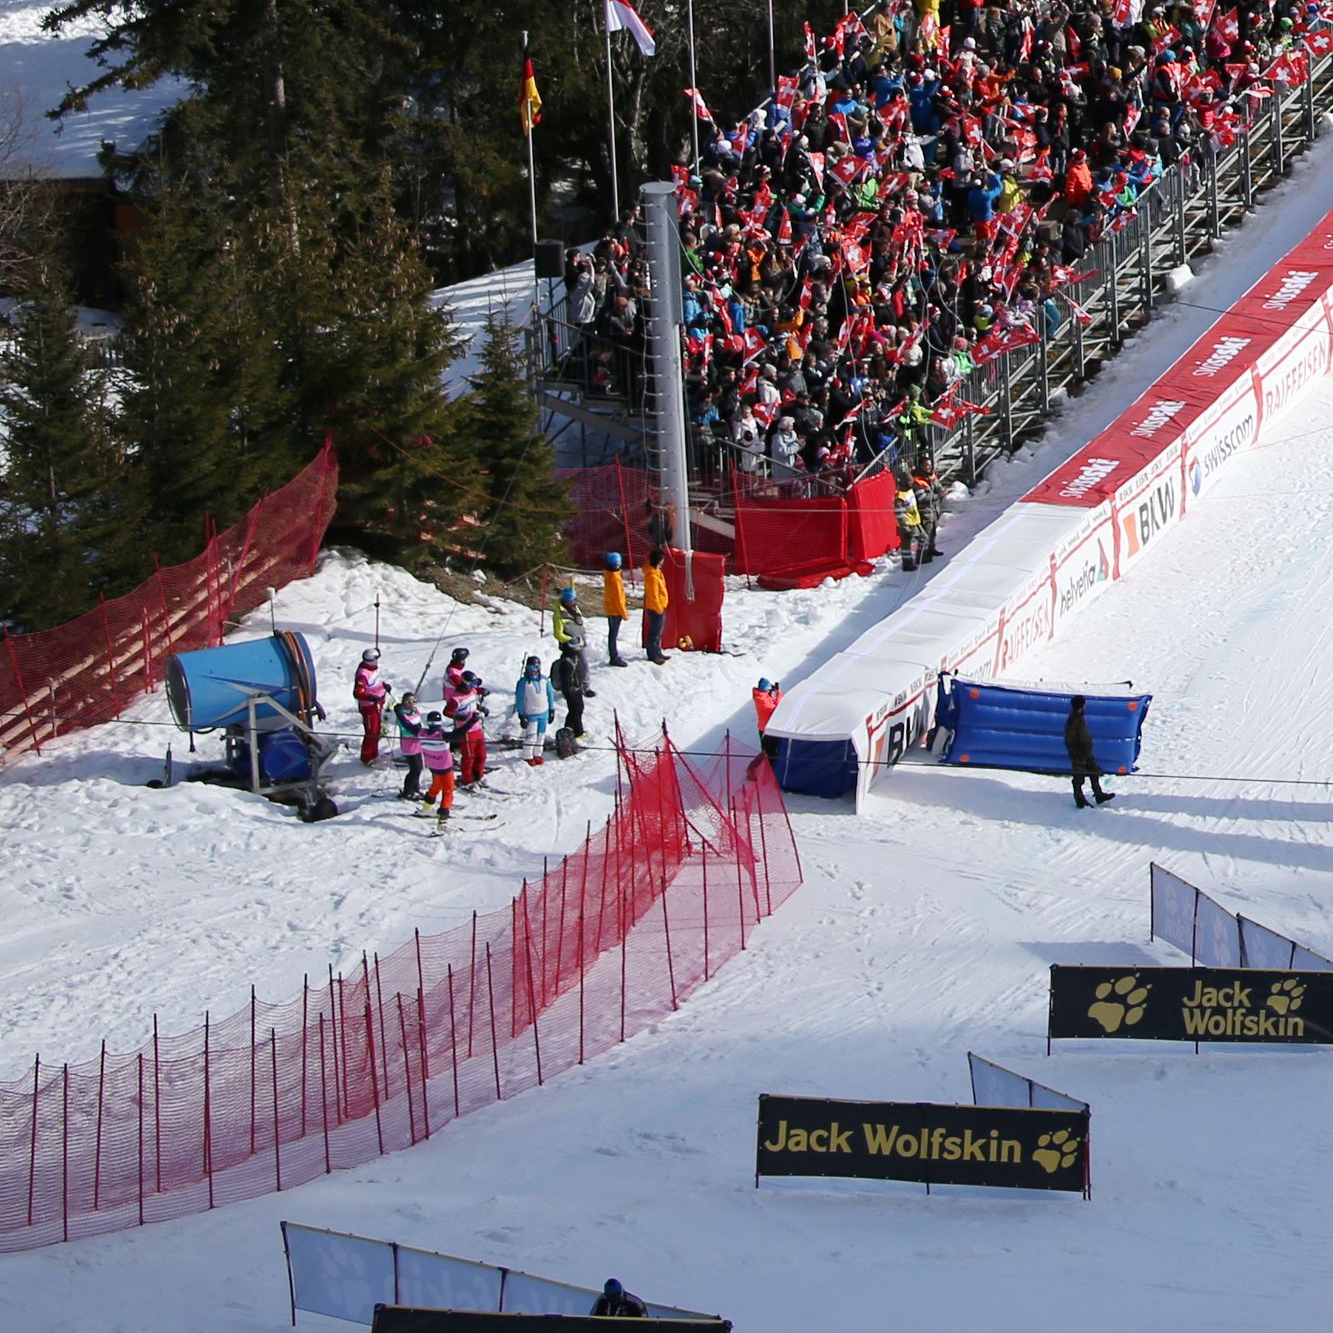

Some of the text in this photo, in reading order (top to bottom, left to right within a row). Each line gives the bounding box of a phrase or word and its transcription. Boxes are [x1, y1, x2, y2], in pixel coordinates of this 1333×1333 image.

[1262, 270, 1318, 311] swissski
[1192, 336, 1252, 378] swissski
[1265, 337, 1326, 418] RAIFFEISEN
[1204, 414, 1254, 479] swisscom
[1060, 458, 1121, 499] swissski
[1139, 476, 1175, 546] BKW
[1060, 560, 1096, 618] helvetia
[1182, 979, 1252, 1009] Jack
[1182, 1008, 1305, 1038] Wolfskin
[764, 1120, 1022, 1164] Jack Wolfskin
